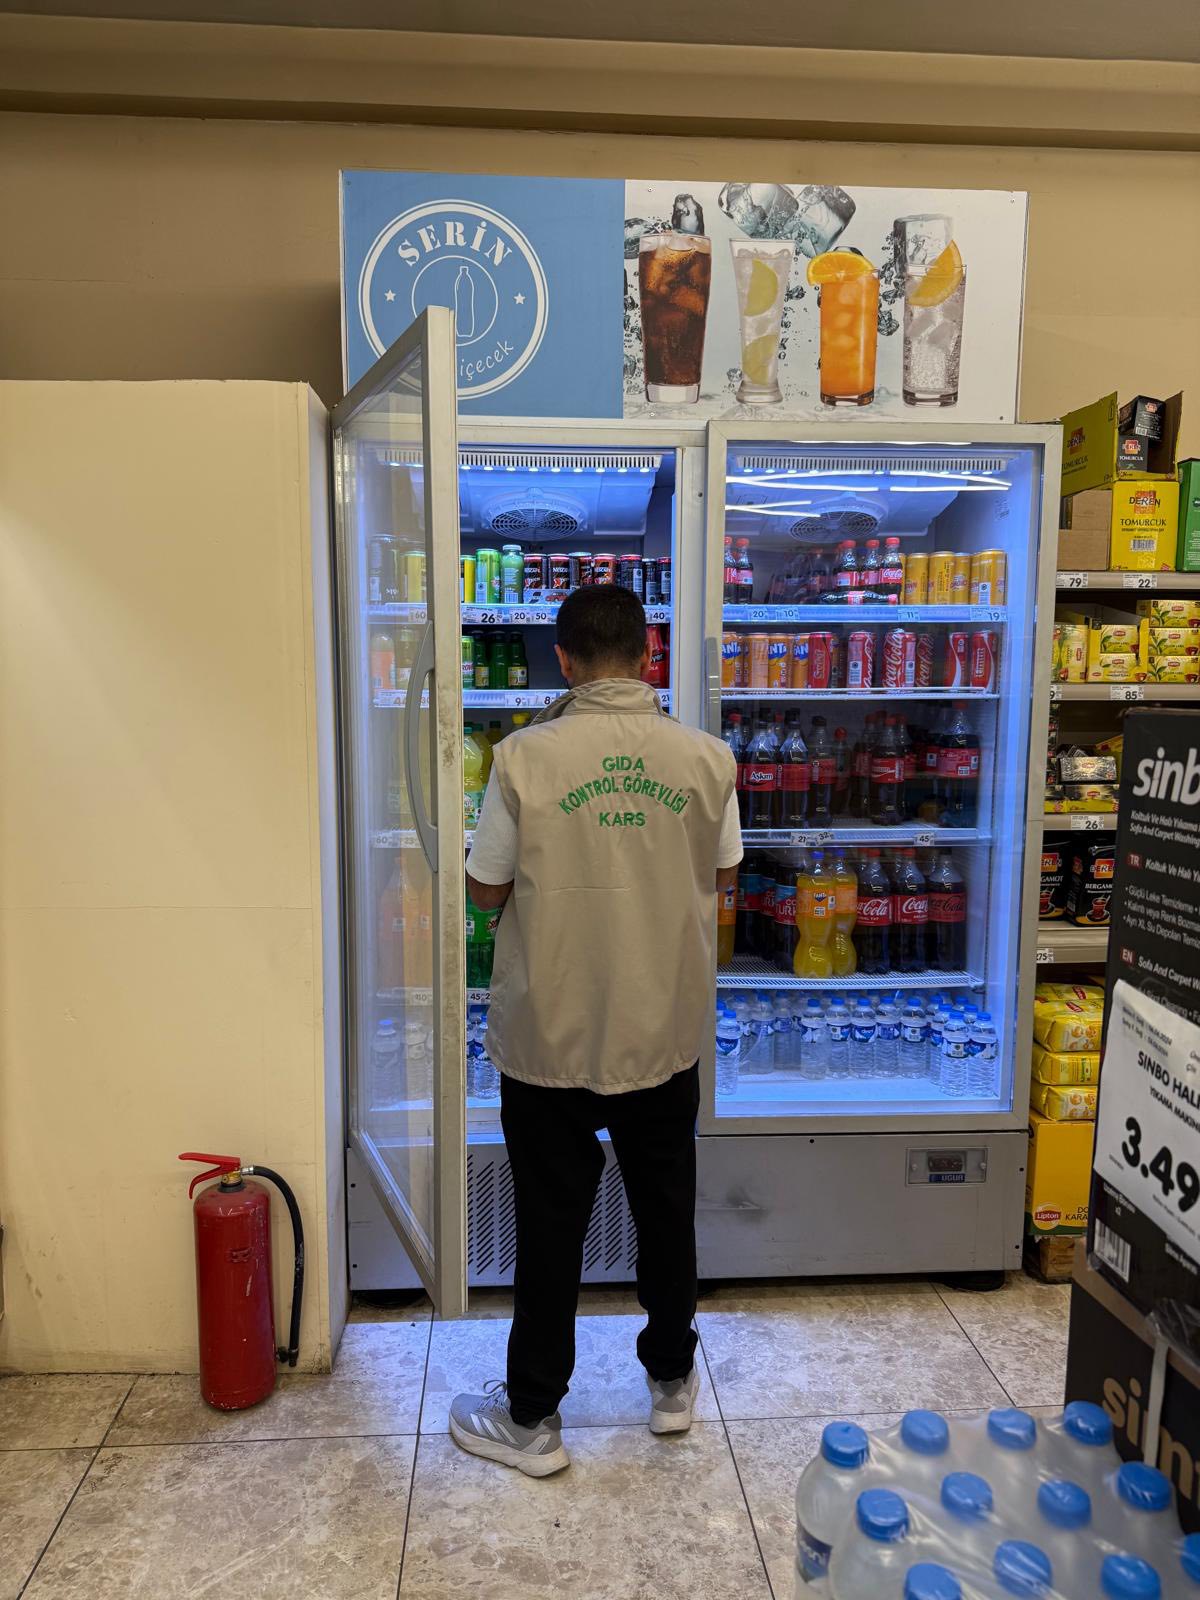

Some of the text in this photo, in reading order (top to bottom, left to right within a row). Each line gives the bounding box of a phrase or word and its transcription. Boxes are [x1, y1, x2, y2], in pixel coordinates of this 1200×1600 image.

[397, 220, 512, 267] SERİN
[459, 339, 514, 381] içecek
[1120, 518, 1167, 527] TOMURCUK
[1069, 577, 1082, 587] 79
[1138, 578, 1151, 588] 22
[481, 612, 496, 624] 26
[514, 612, 526, 620] 20
[535, 612, 547, 620] 50
[653, 612, 665, 620] 40
[753, 610, 764, 618] 20
[784, 609, 794, 618] 10
[988, 611, 1000, 621] 19
[1125, 691, 1138, 700] 85
[515, 697, 522, 706] 9
[602, 755, 645, 773] GIDA
[559, 772, 691, 815] KONTROL GÖREVLİSİ
[599, 812, 646, 827] KARS
[1085, 820, 1099, 830] 26
[1129, 853, 1140, 867] TR
[1122, 948, 1133, 964] EN
[1153, 962, 1168, 977] And
[1138, 1050, 1170, 1087] SINBO
[1036, 1212, 1059, 1220] Lipton
